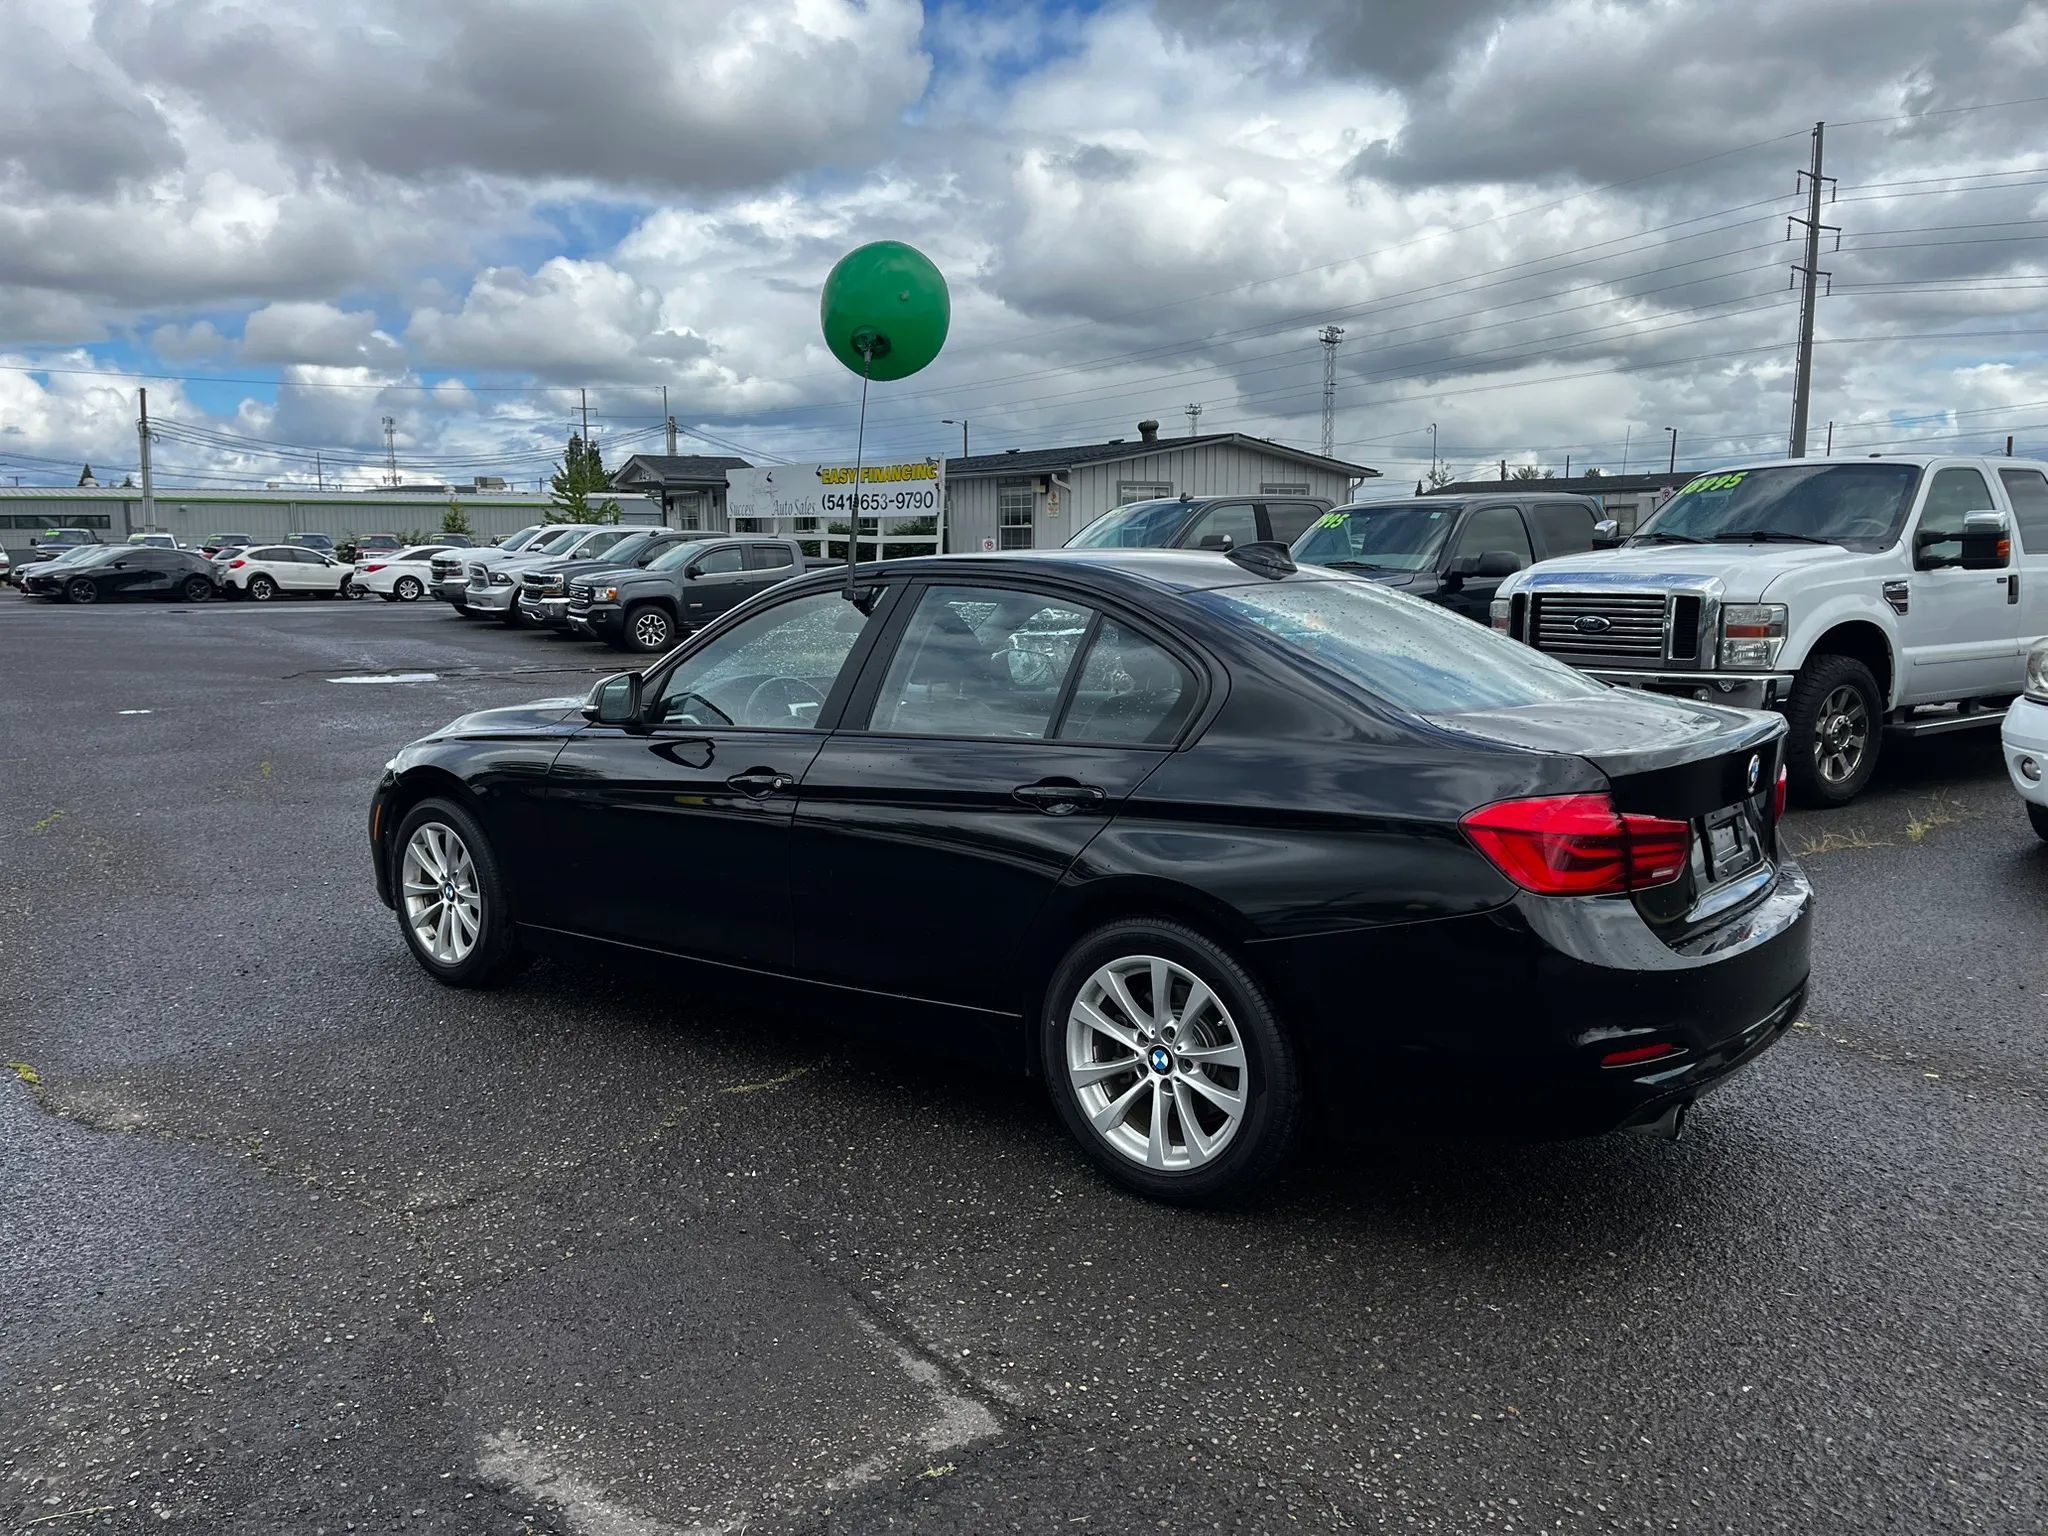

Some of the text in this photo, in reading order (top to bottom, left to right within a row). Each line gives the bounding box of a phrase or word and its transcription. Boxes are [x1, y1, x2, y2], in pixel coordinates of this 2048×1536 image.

[821, 463, 938, 485] EASY FINANCING
[728, 496, 817, 517] Success Auto Sales
[821, 490, 934, 511] (541653-9790
